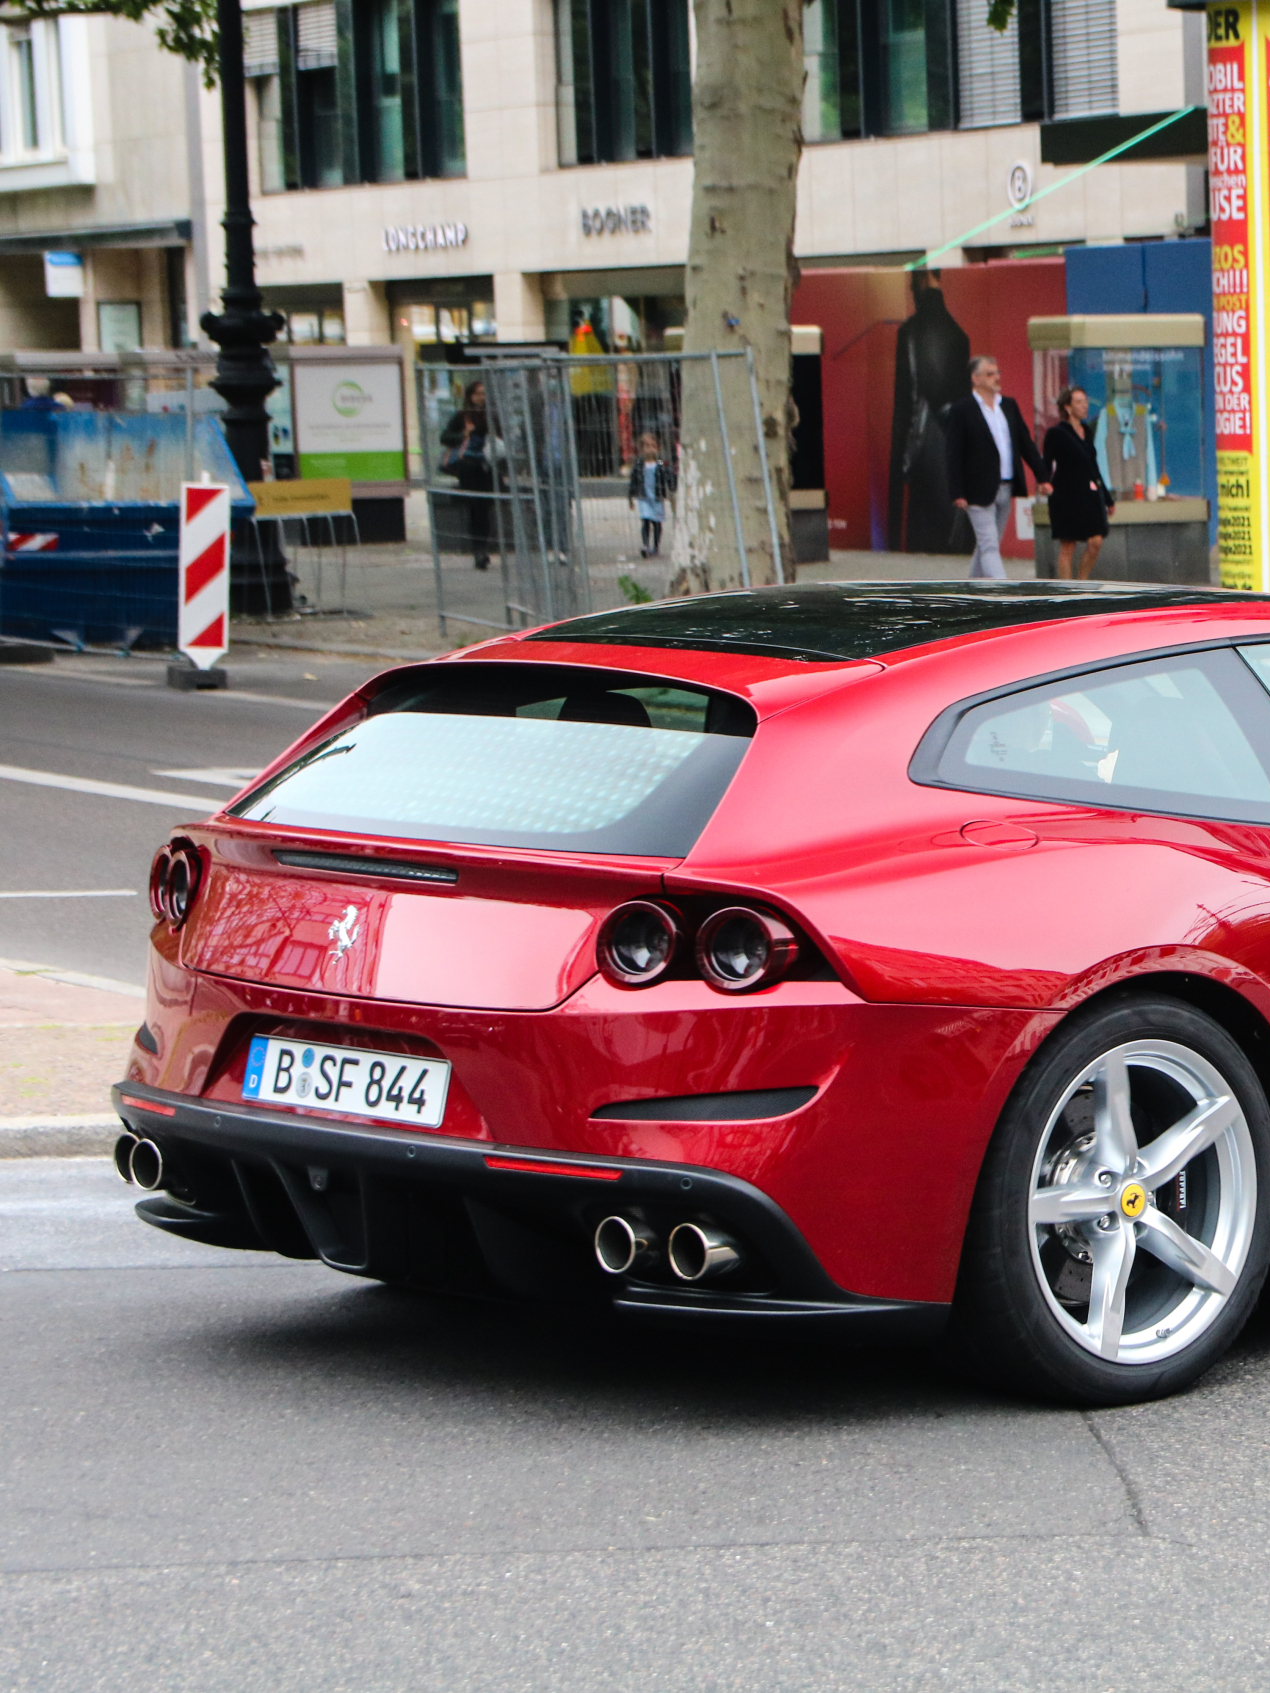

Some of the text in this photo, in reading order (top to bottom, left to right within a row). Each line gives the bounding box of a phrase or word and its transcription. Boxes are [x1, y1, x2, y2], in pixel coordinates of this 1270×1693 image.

[580, 205, 652, 236] BOGNER
[383, 222, 469, 252] LONGCHAMP
[248, 1074, 259, 1089] D
[272, 1047, 297, 1095] B
[314, 1053, 361, 1103] SF
[364, 1060, 430, 1115] 844
